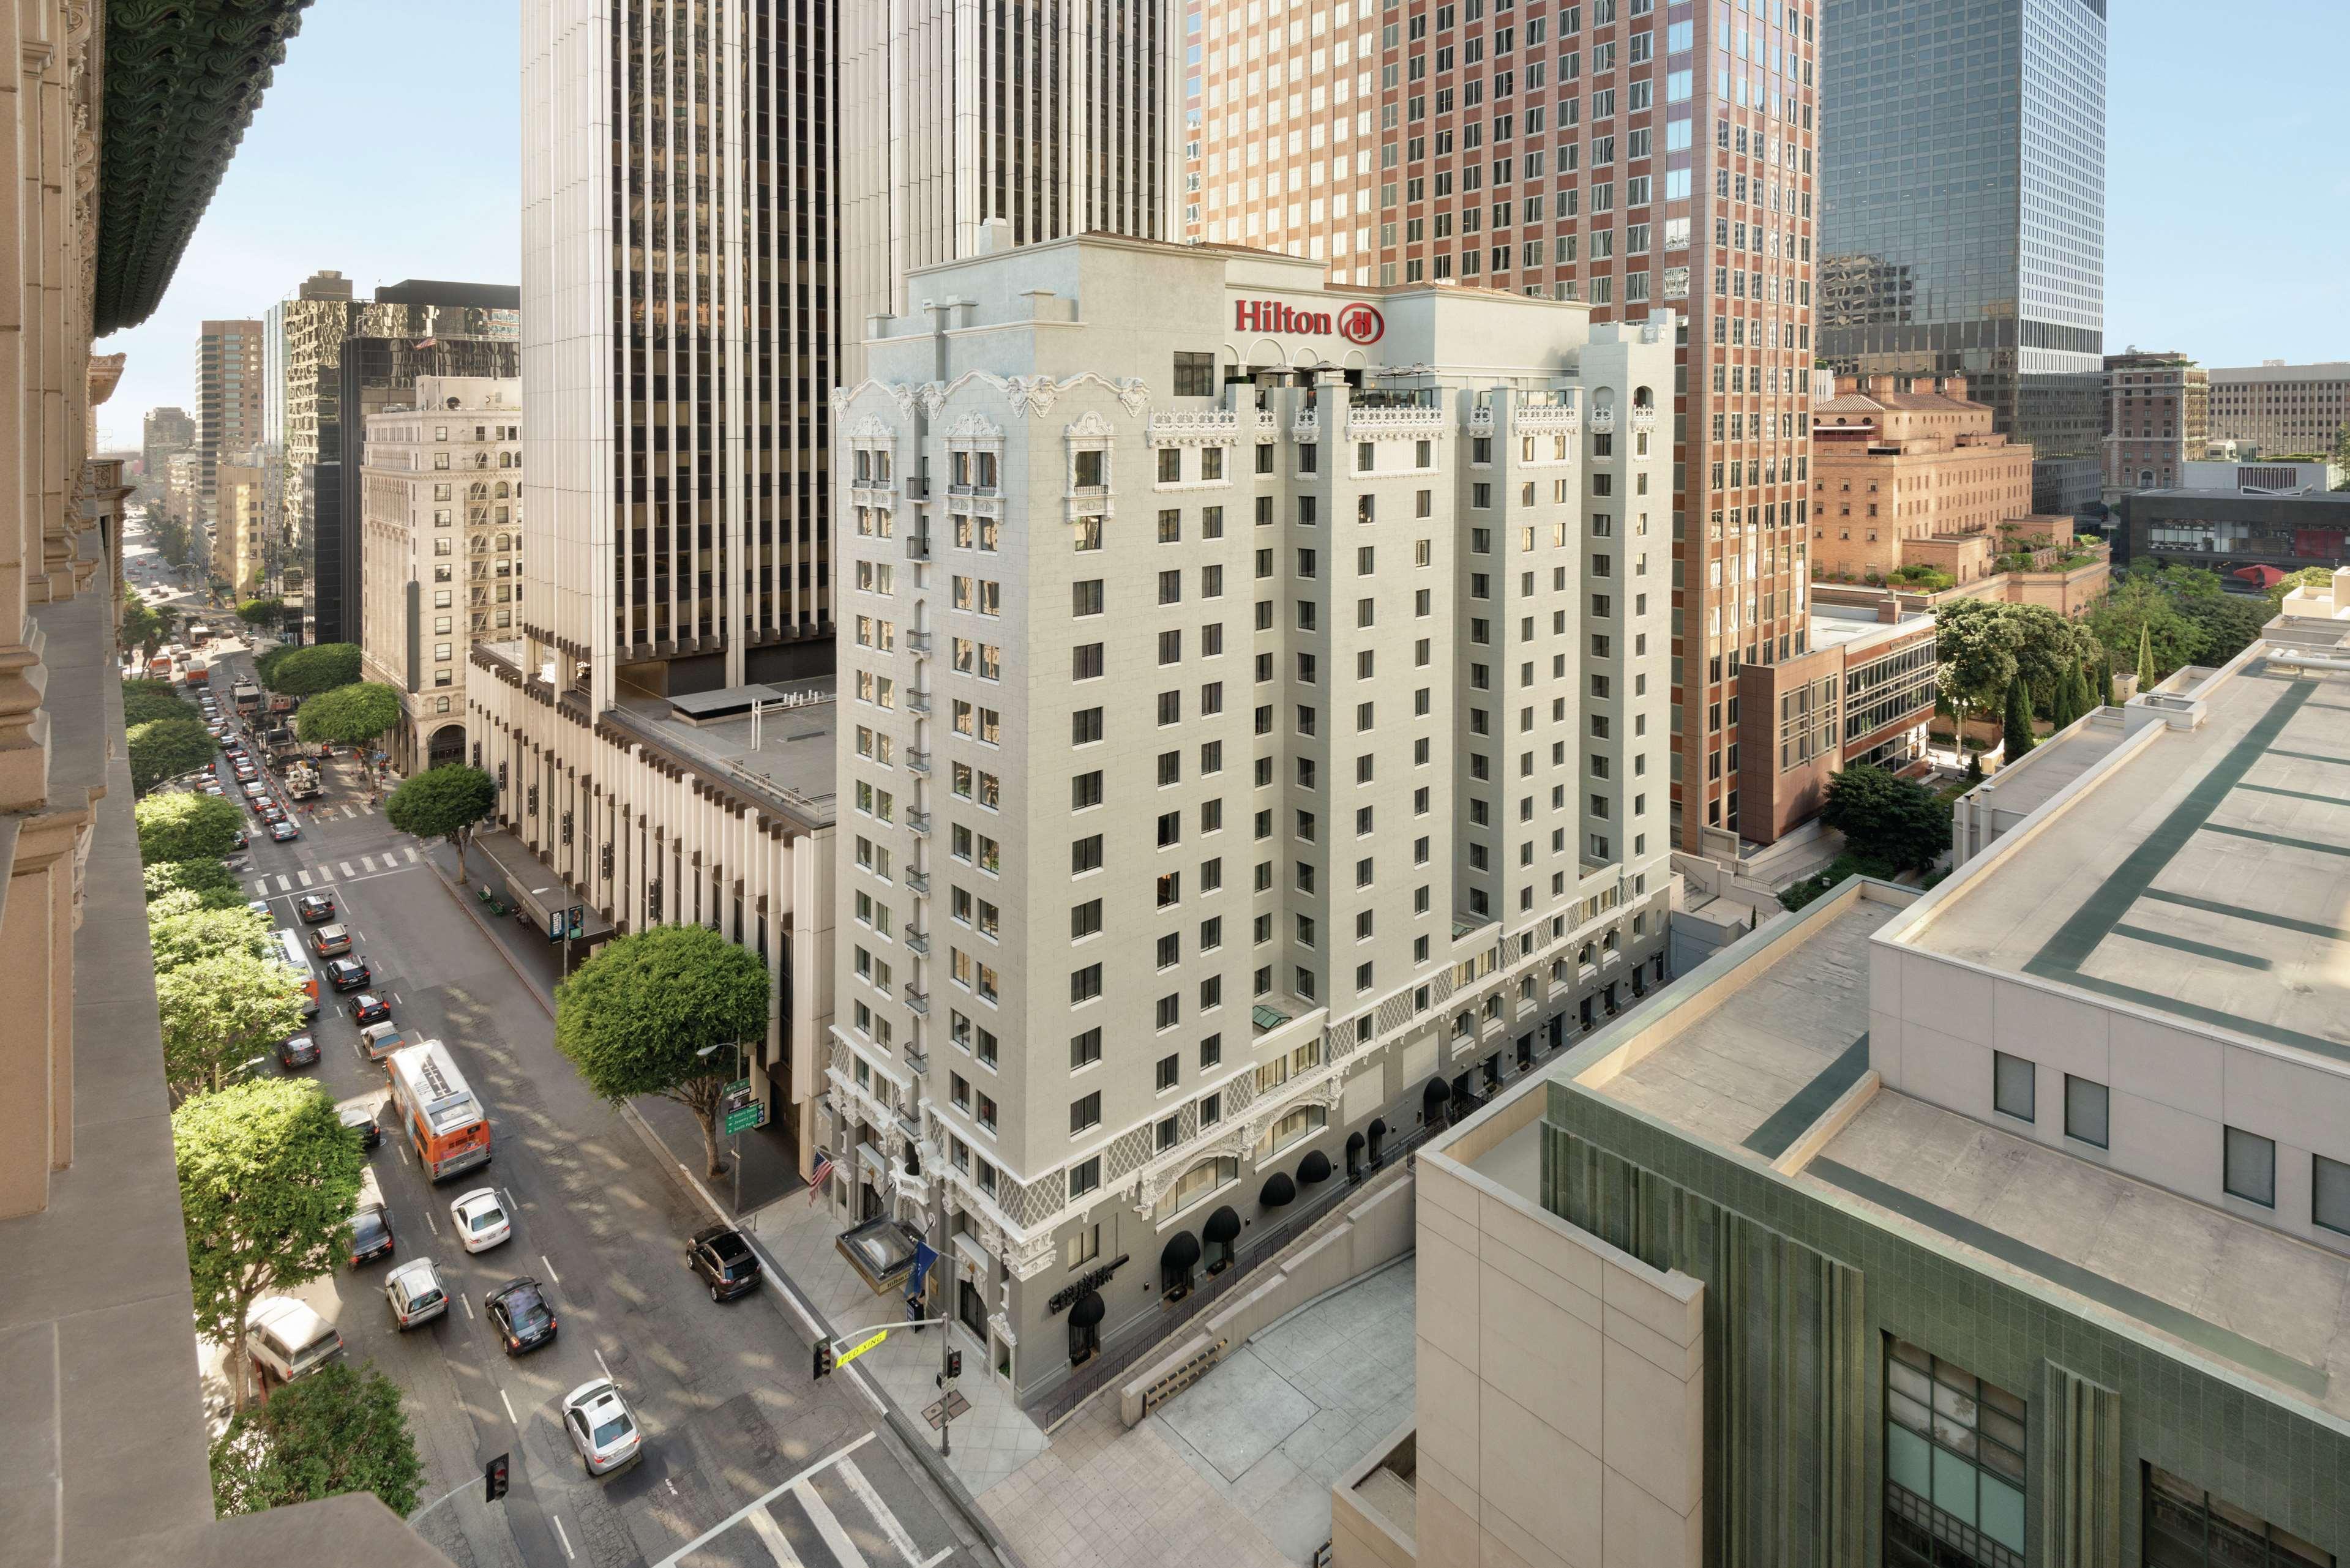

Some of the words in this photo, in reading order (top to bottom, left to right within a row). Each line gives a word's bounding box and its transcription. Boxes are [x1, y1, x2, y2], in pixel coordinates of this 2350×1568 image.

[1235, 300, 1332, 335] Hilton
[841, 1349, 859, 1364] PED
[863, 1335, 882, 1352] XING
